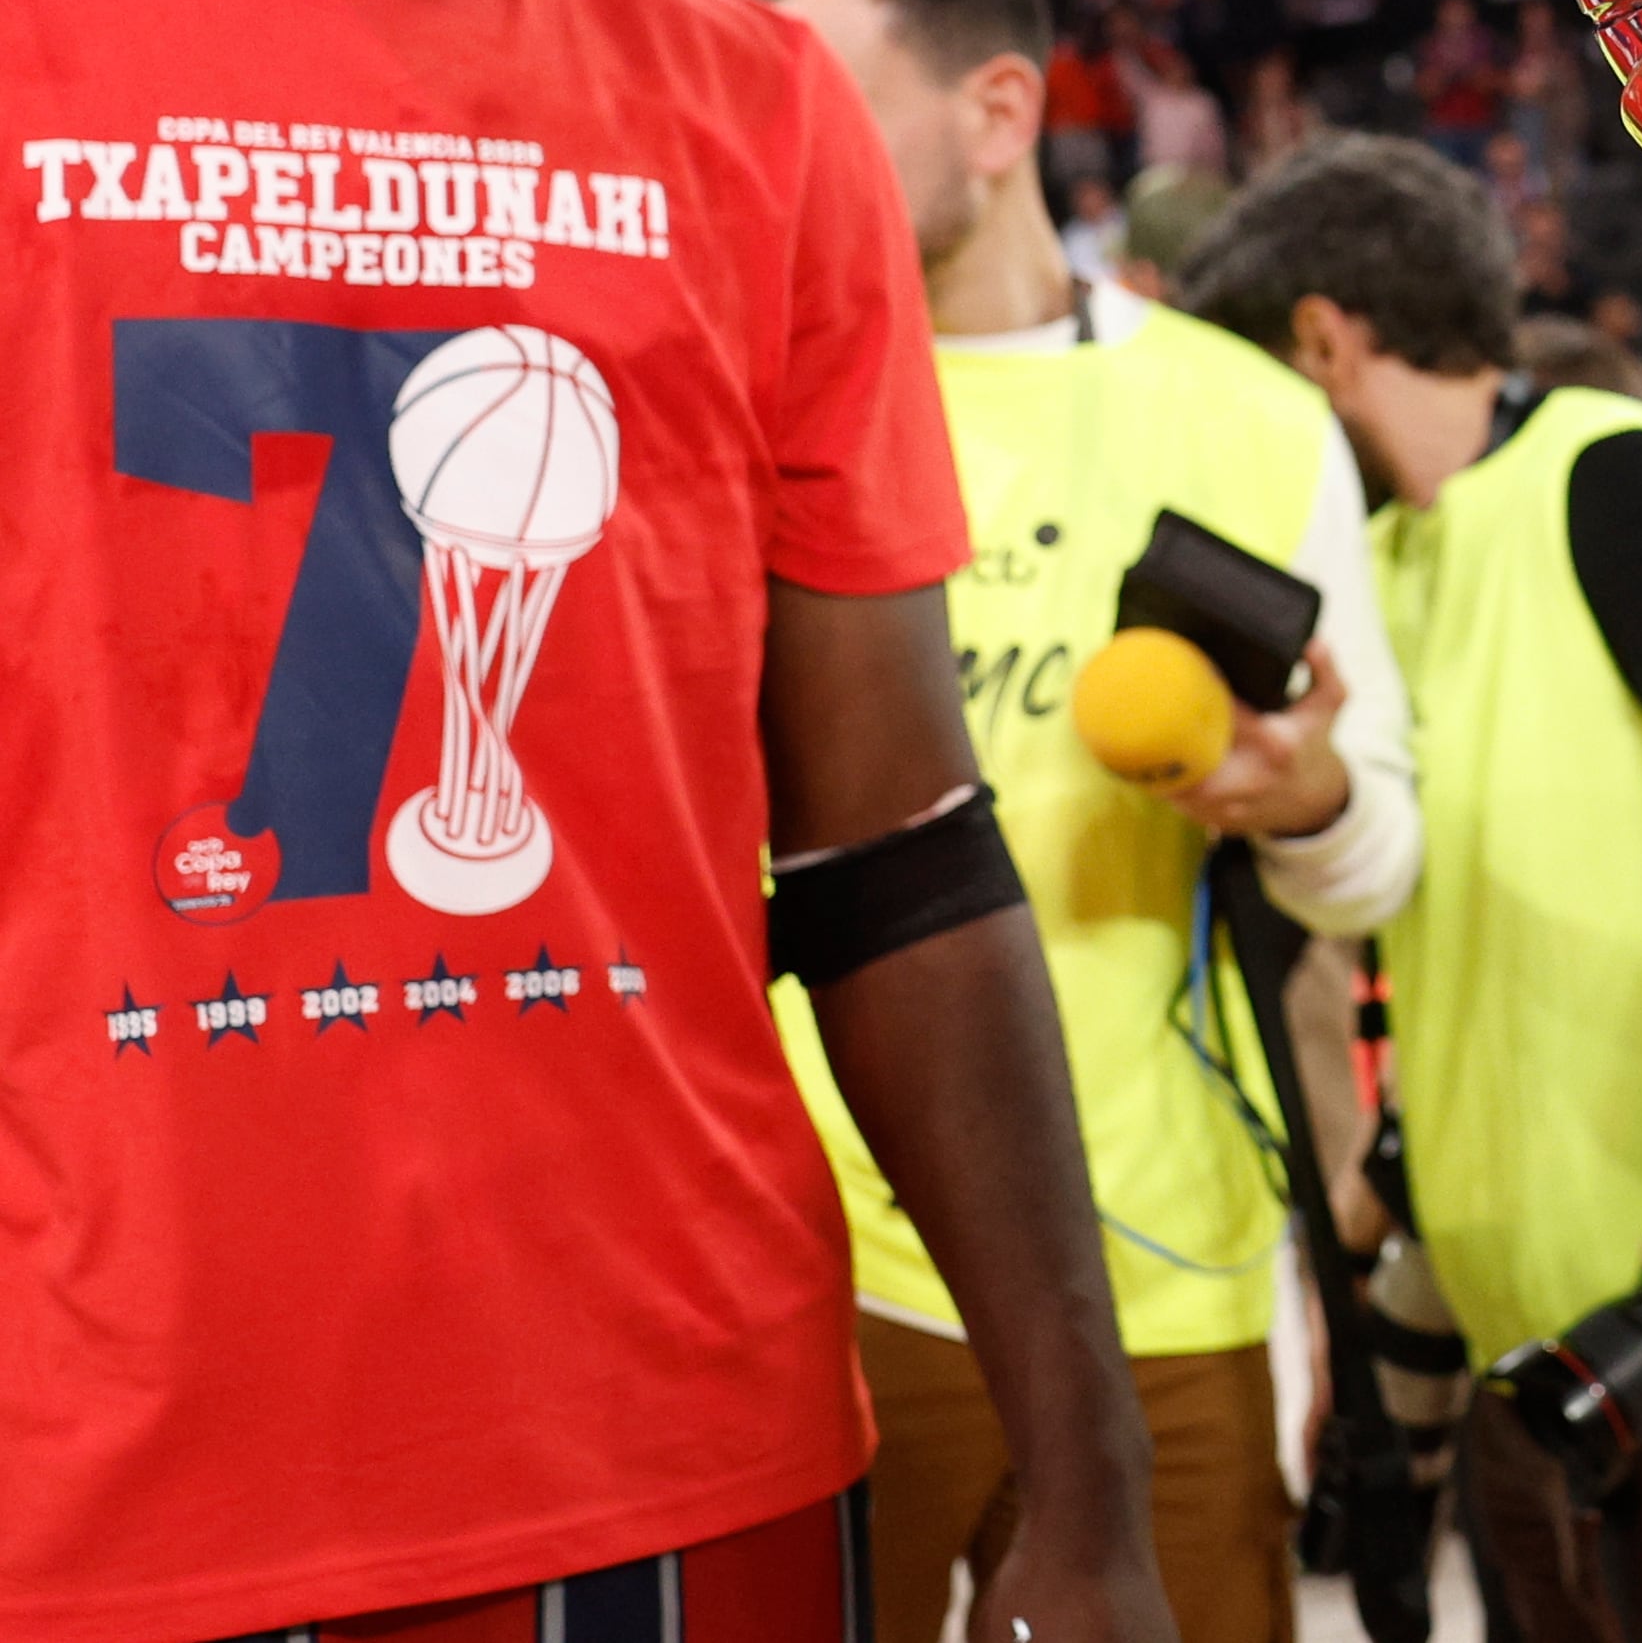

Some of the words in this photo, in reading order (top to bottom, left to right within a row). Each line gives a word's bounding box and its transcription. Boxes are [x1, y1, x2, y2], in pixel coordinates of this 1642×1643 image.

[157, 115, 231, 144] COPA
[233, 119, 287, 150] DEL
[289, 122, 344, 152] REY
[347, 127, 475, 160] VALENCIA
[23, 138, 670, 259] TXAPELDUNAK!
[180, 220, 536, 289] CAMPEONES
[196, 996, 267, 1031] 1999
[301, 984, 380, 1020] 2002
[403, 977, 478, 1011] 2004
